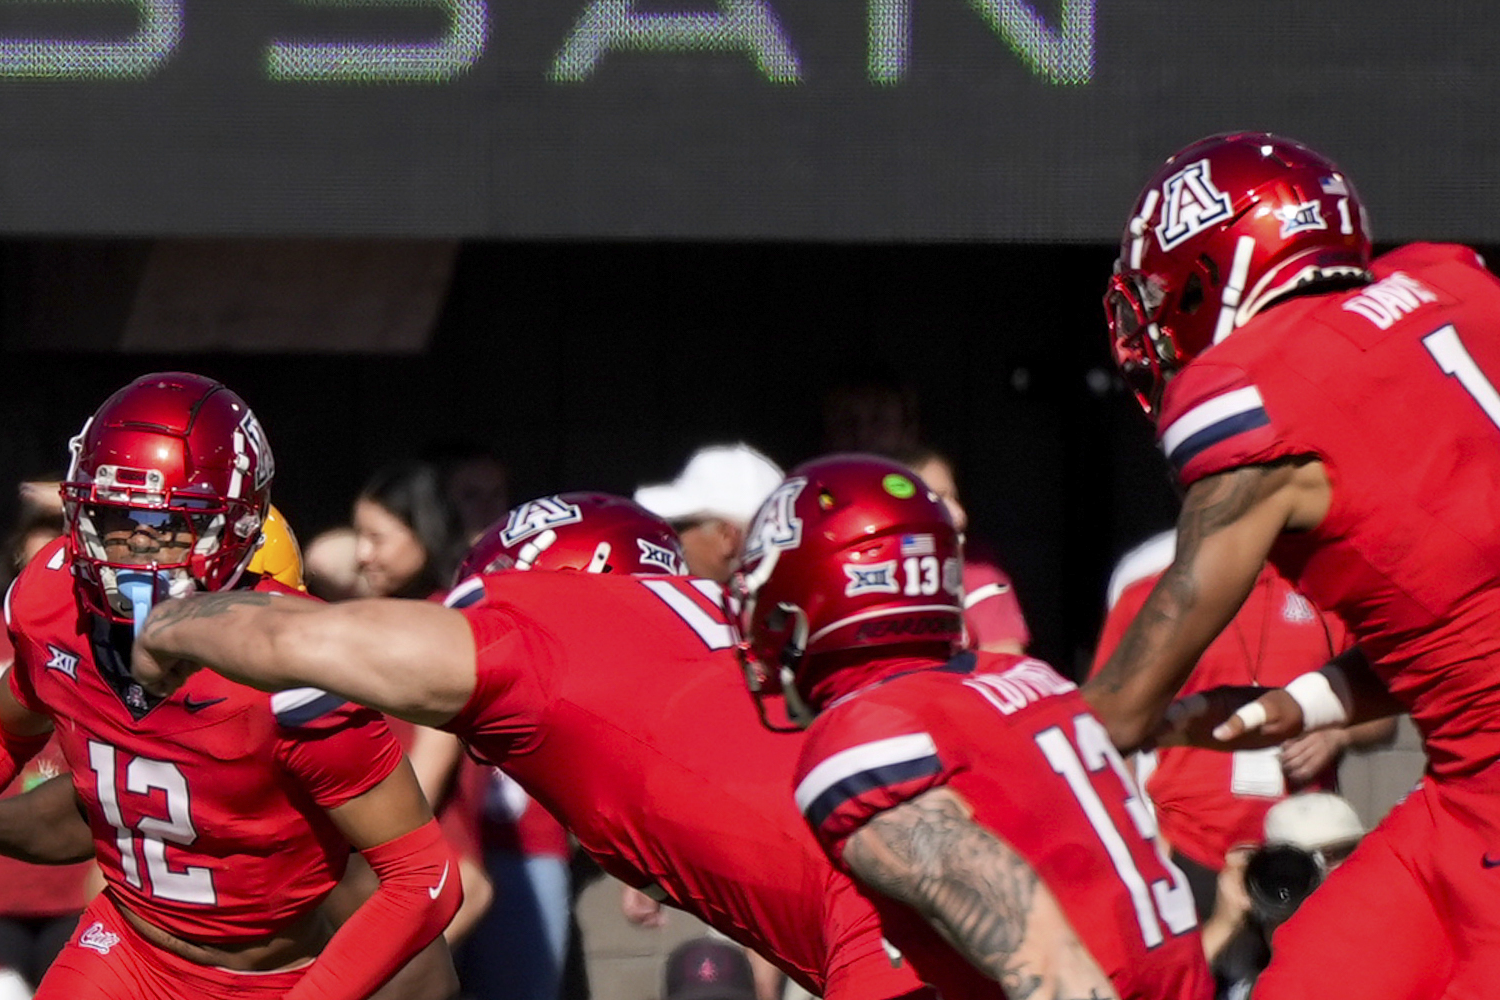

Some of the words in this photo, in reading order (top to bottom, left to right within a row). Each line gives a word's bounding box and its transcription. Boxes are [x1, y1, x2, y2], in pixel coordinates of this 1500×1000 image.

[1155, 159, 1234, 252] A
[1337, 198, 1353, 235] 1
[500, 496, 583, 548] A
[847, 563, 898, 595] XII
[903, 556, 940, 596] 13
[87, 739, 218, 907] 12
[1033, 711, 1198, 951] 13
